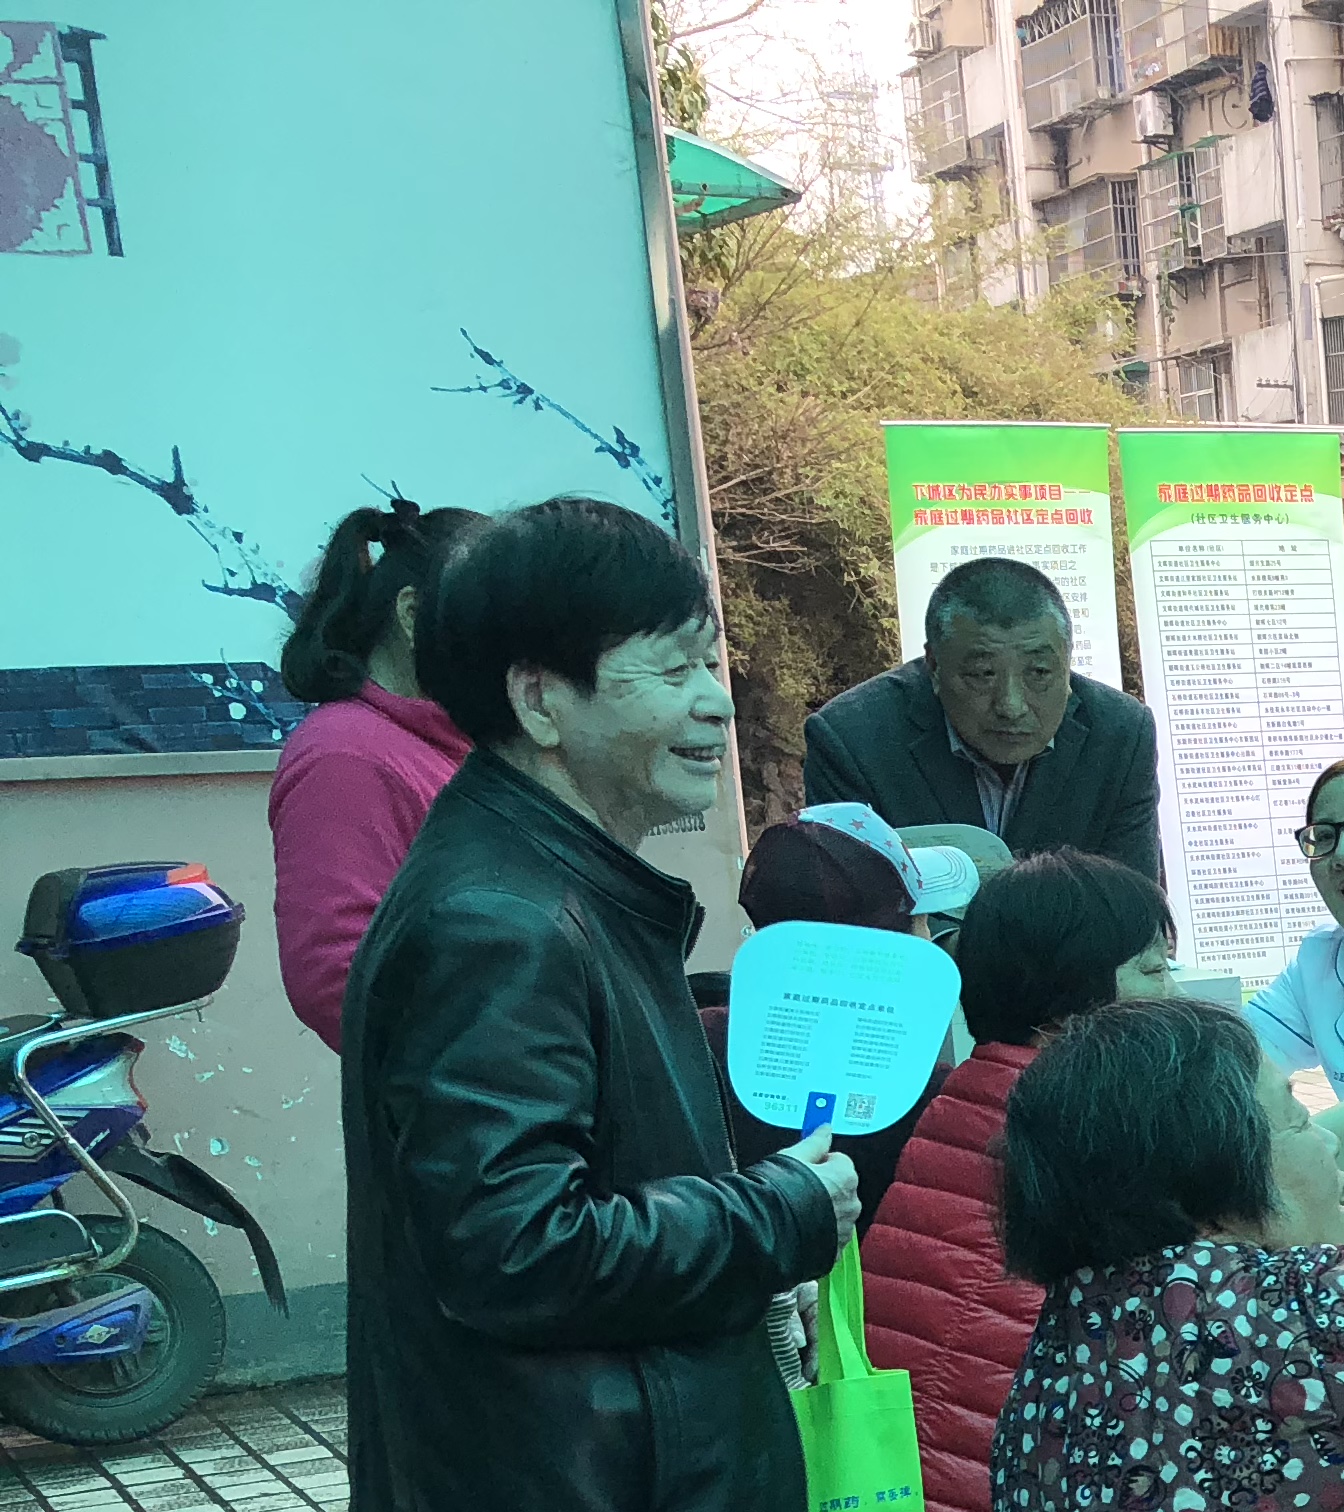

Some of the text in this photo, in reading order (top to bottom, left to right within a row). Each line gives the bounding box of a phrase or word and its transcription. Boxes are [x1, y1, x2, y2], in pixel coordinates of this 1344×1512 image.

[1158, 484, 1315, 502] 家庭过期药品回收定点
[914, 509, 1094, 525] 家庭过期药品社区定点回收
[1191, 513, 1290, 525] (社区卫生服务中心)
